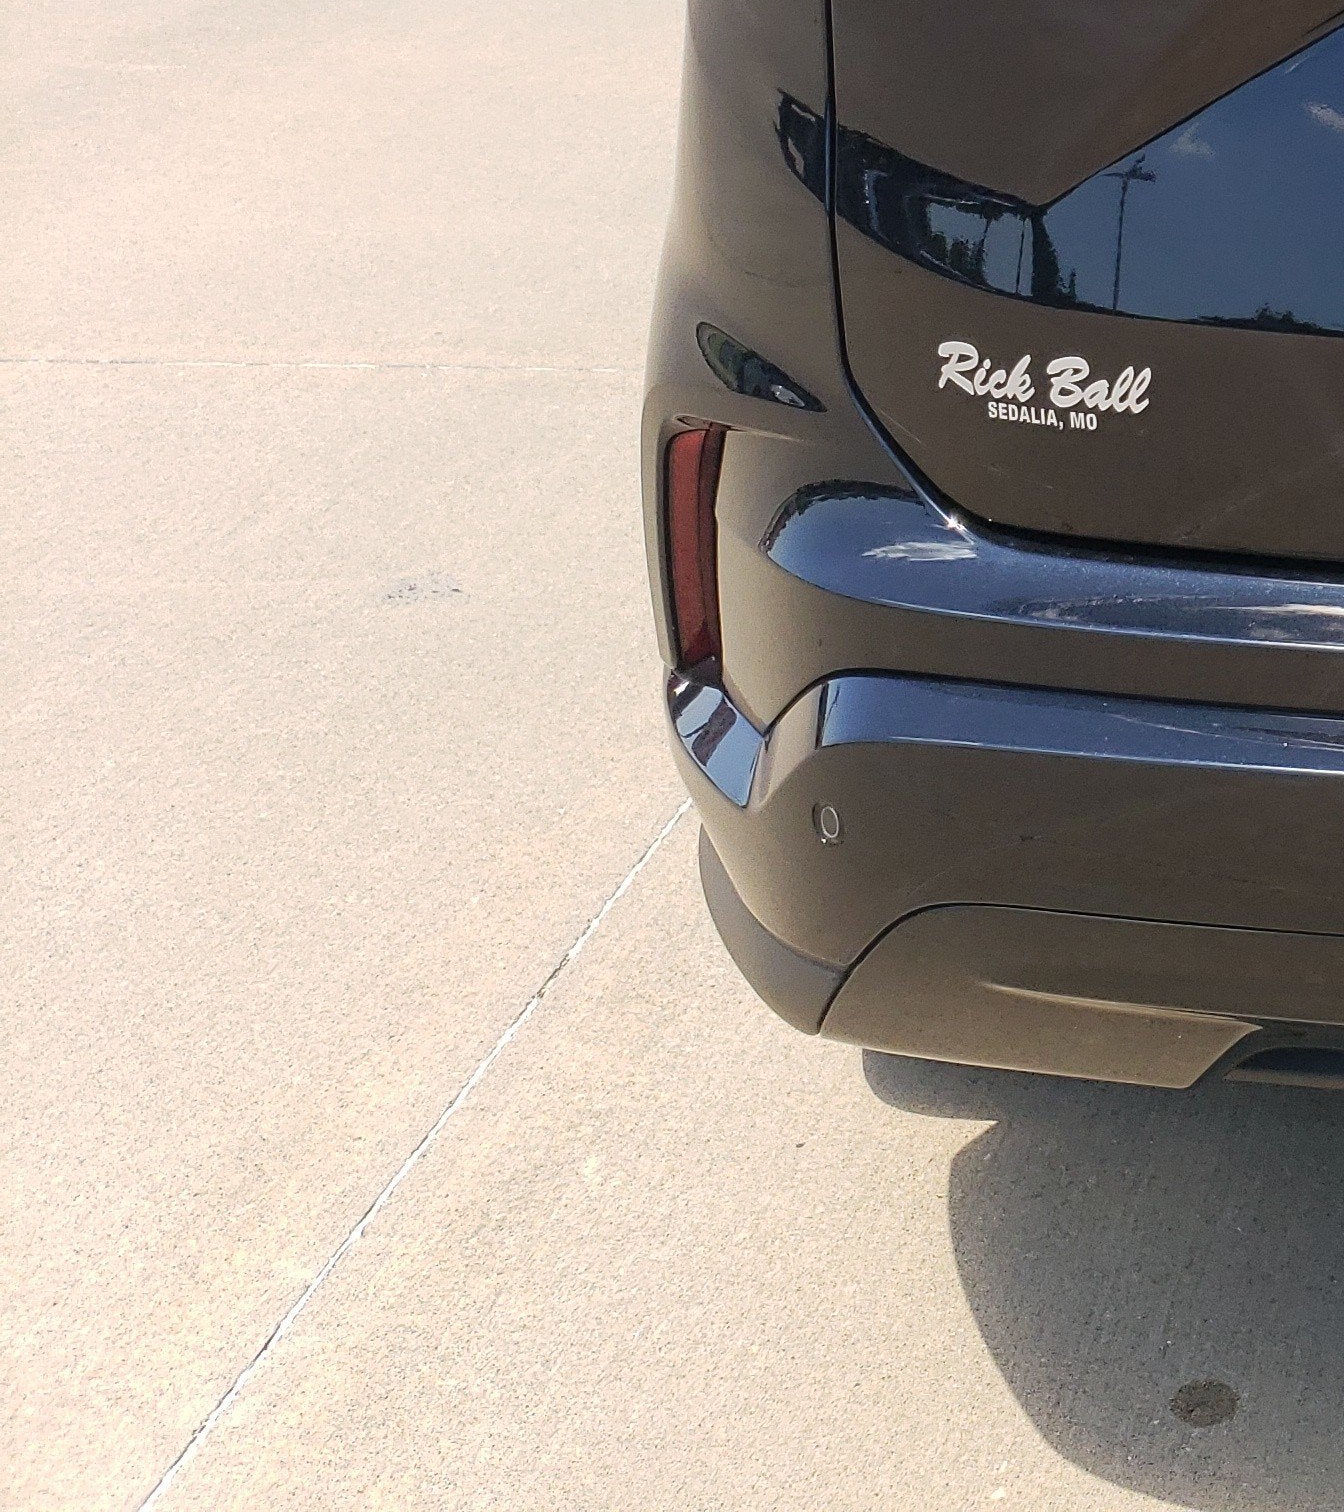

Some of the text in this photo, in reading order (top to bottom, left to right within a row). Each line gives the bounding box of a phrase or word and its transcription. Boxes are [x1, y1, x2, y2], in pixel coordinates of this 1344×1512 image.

[937, 341, 1152, 414] Rick Ball
[988, 401, 1098, 430] SEDALIA, MO
